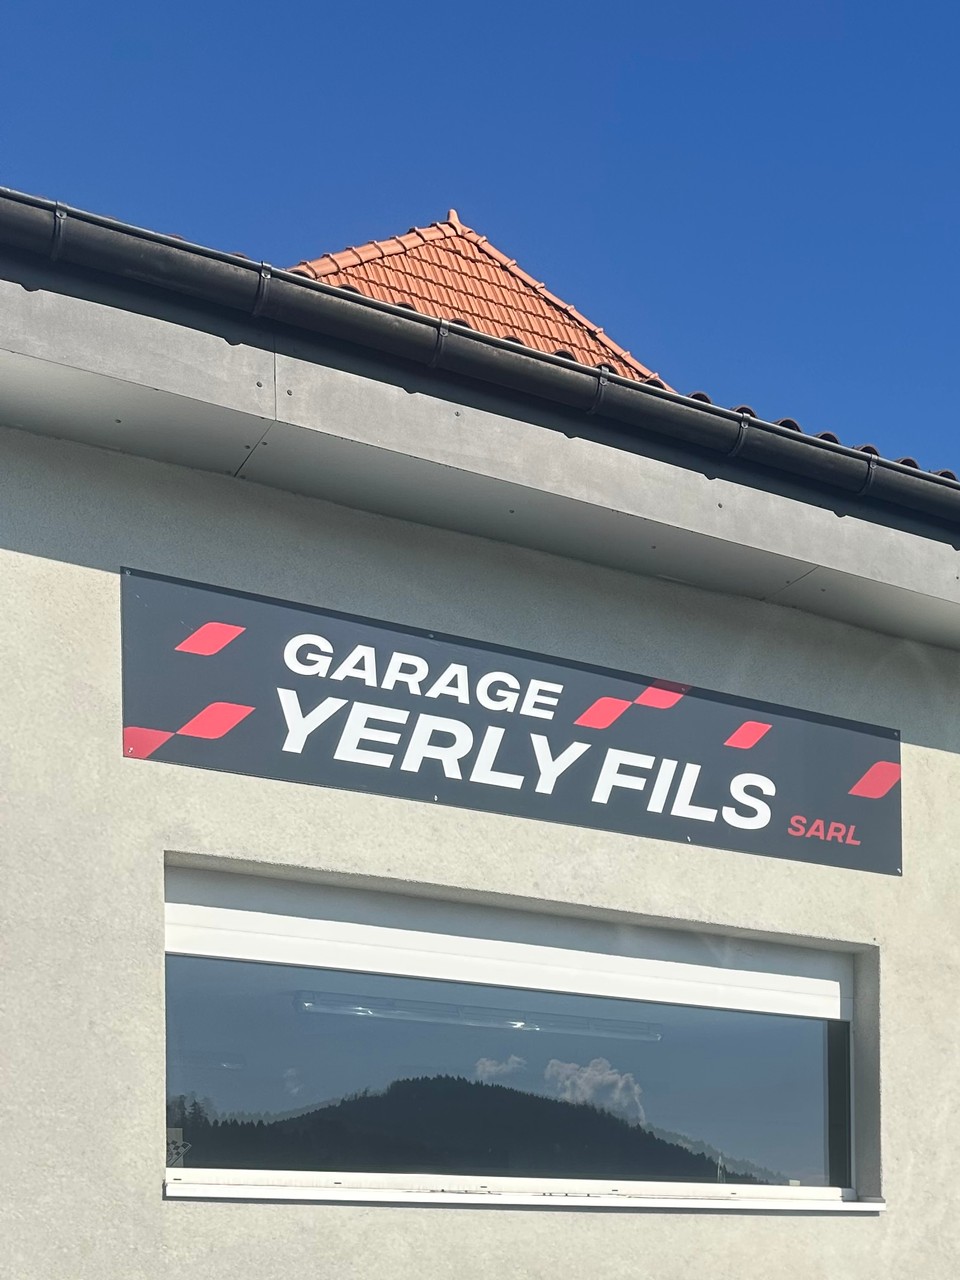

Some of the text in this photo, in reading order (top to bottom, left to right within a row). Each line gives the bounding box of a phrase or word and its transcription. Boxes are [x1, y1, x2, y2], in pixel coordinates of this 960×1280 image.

[283, 633, 564, 721] GARAGE
[275, 687, 862, 846] YERLY FILS SARL
